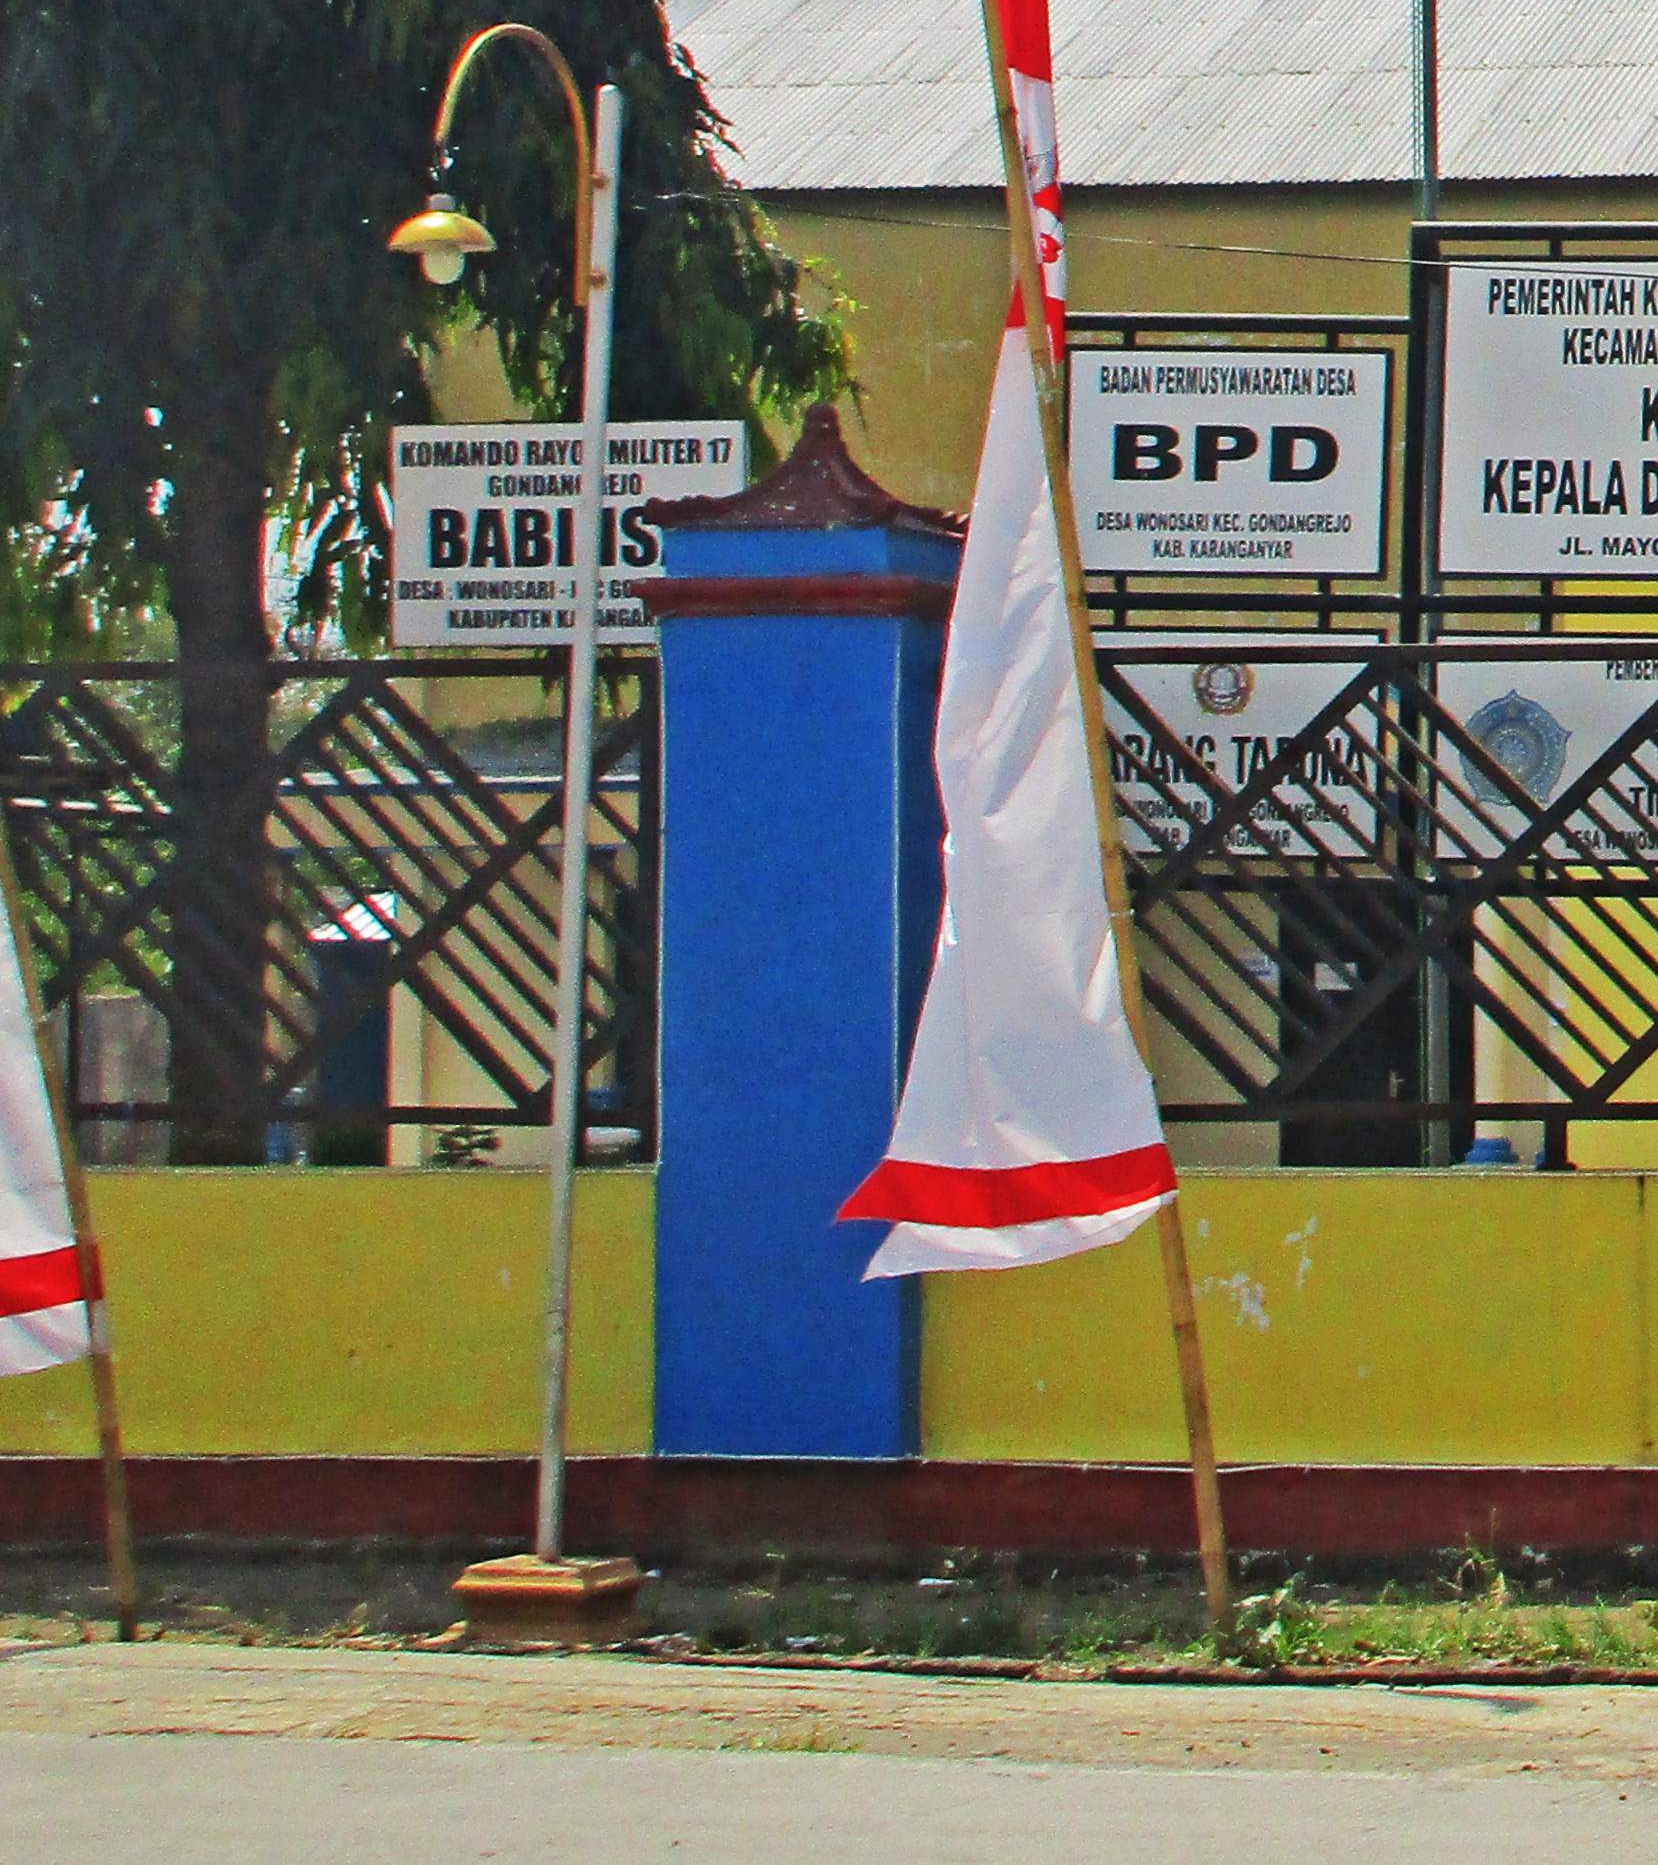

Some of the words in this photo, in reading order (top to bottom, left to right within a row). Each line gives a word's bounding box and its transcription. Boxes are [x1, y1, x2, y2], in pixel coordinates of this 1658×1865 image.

[1488, 278, 1635, 317] PEMERINTAH
[1099, 366, 1150, 394] BADAN
[1156, 366, 1312, 395] PERMUSYAWARATAN
[1317, 368, 1356, 396] DESA
[401, 440, 519, 467] KOMANDO
[527, 439, 584, 466] RAYO
[607, 438, 702, 464] MILITER
[709, 437, 733, 463] 17
[1112, 424, 1339, 483] BPD
[487, 473, 643, 497] GONDANEJO
[1482, 459, 1628, 515] KEPALA
[1097, 512, 1131, 531] DESA
[1137, 513, 1208, 532] WONOSARI
[1213, 513, 1244, 532] KEC.
[1249, 514, 1351, 534] GONDANGREJO
[428, 506, 663, 569] BABIS
[1153, 540, 1185, 559] KAB.
[1189, 540, 1293, 560] KARANGANYAR
[1558, 536, 1592, 557] JL.
[456, 580, 555, 600] WONOSARI
[448, 609, 551, 629] KABUPATEN
